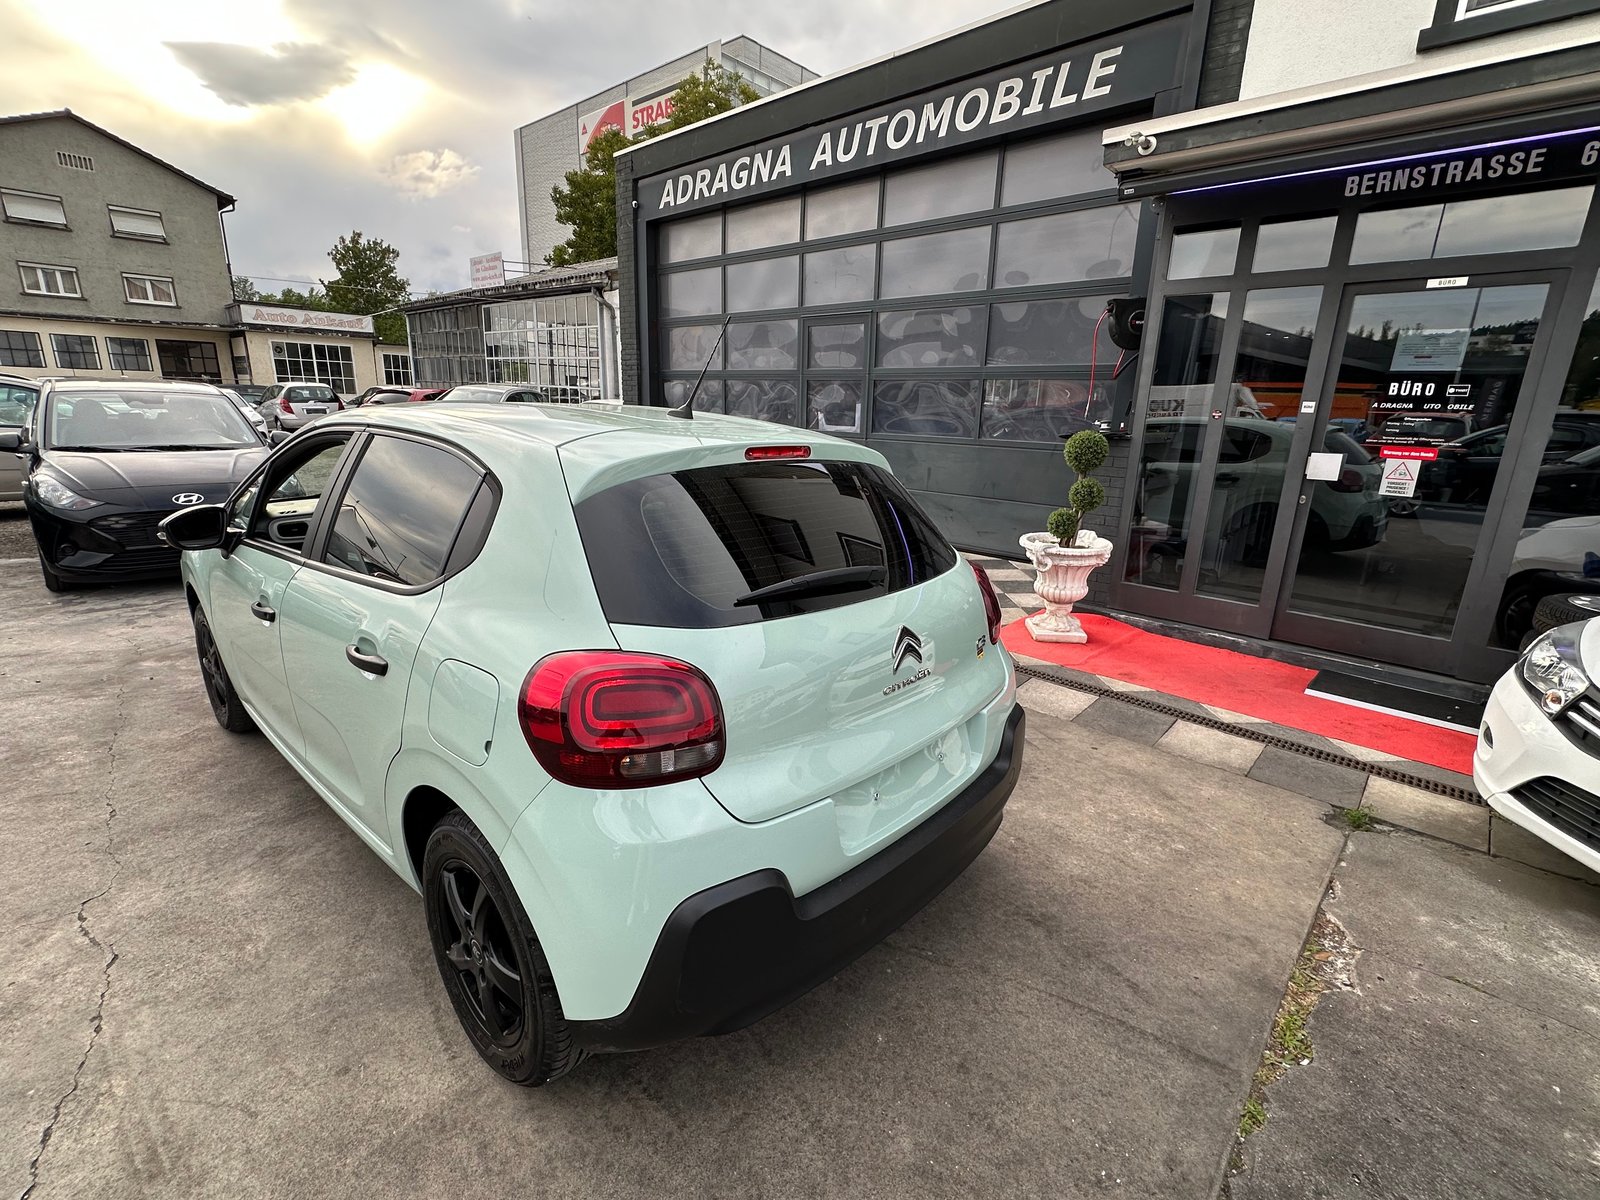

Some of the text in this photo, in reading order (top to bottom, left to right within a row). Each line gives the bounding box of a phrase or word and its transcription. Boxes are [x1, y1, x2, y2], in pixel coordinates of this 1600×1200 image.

[632, 97, 674, 129] STRAB
[658, 46, 1124, 209] ADRAGNA AUTOMOBILE
[1344, 148, 1547, 197] BERNSTRASSE
[253, 308, 367, 329] Auto Ankauf
[1388, 380, 1436, 396] BÜRO
